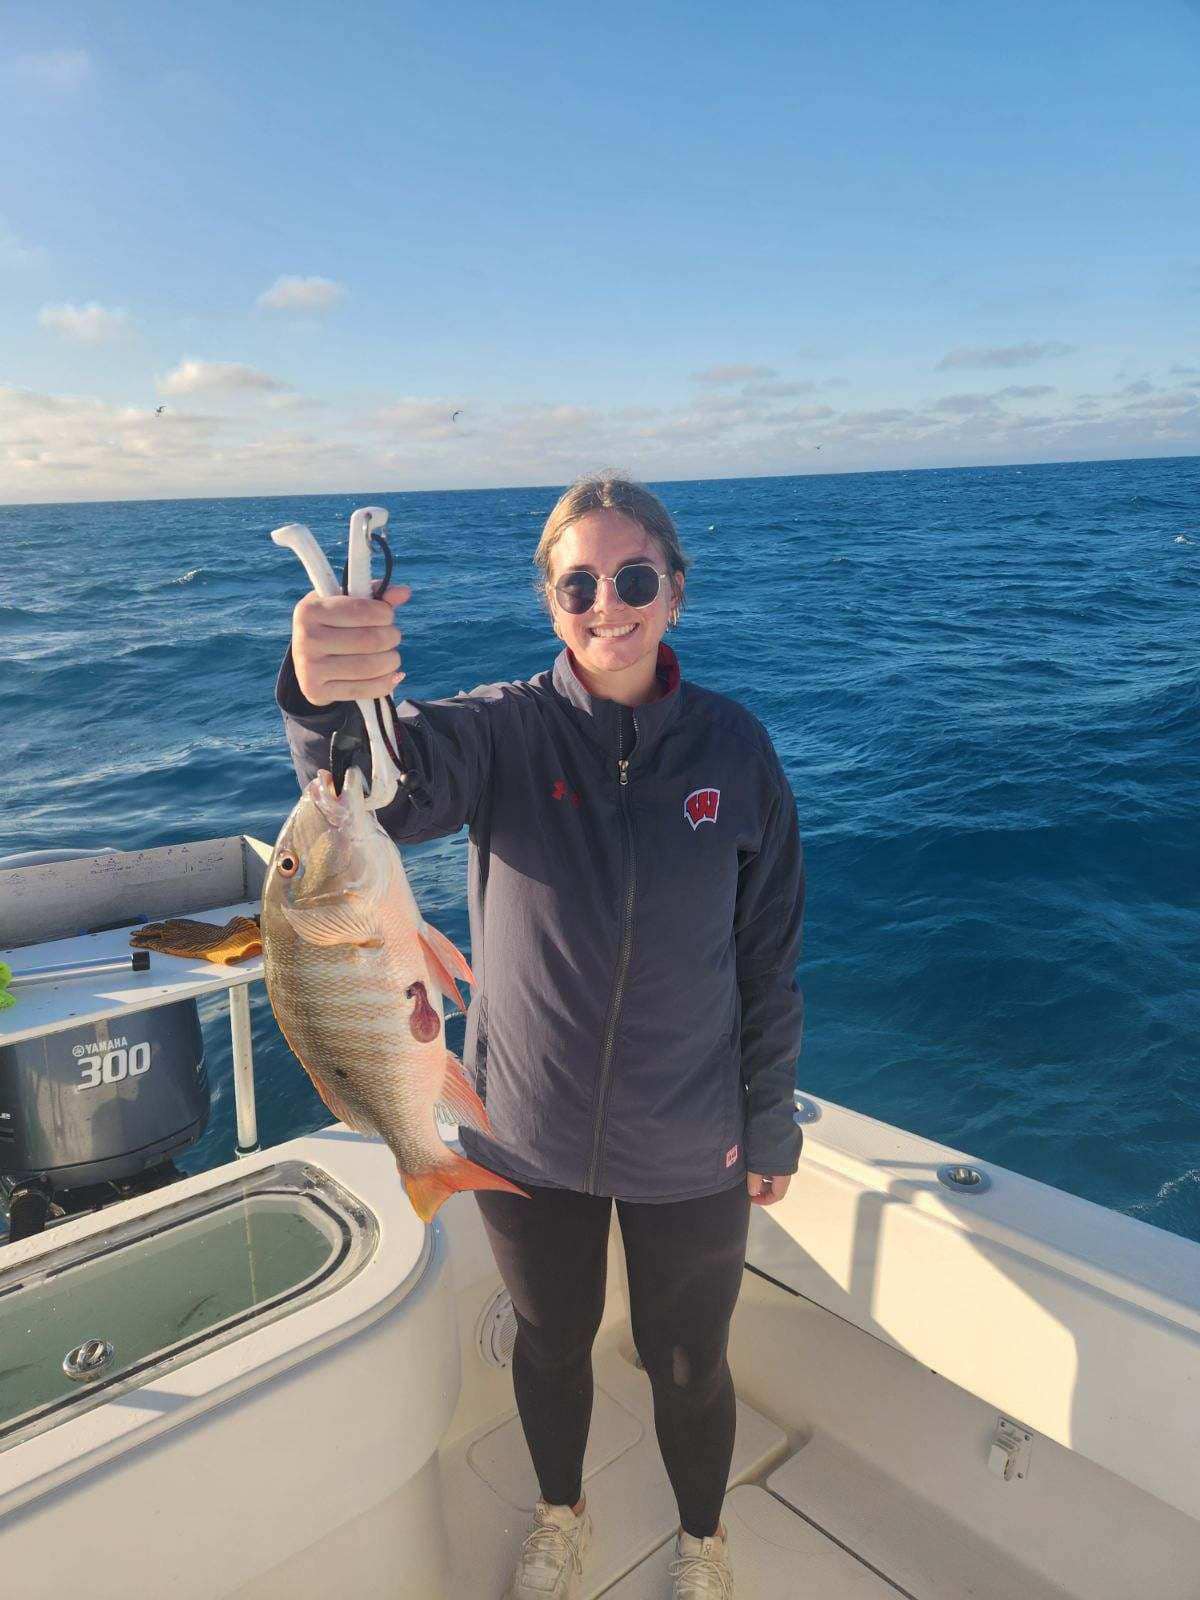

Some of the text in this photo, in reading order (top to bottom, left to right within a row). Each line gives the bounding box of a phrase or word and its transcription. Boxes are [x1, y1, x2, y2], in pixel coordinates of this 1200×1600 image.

[683, 787, 721, 831] W
[77, 1041, 151, 1091] 300
[85, 1036, 128, 1054] YAMAHA
